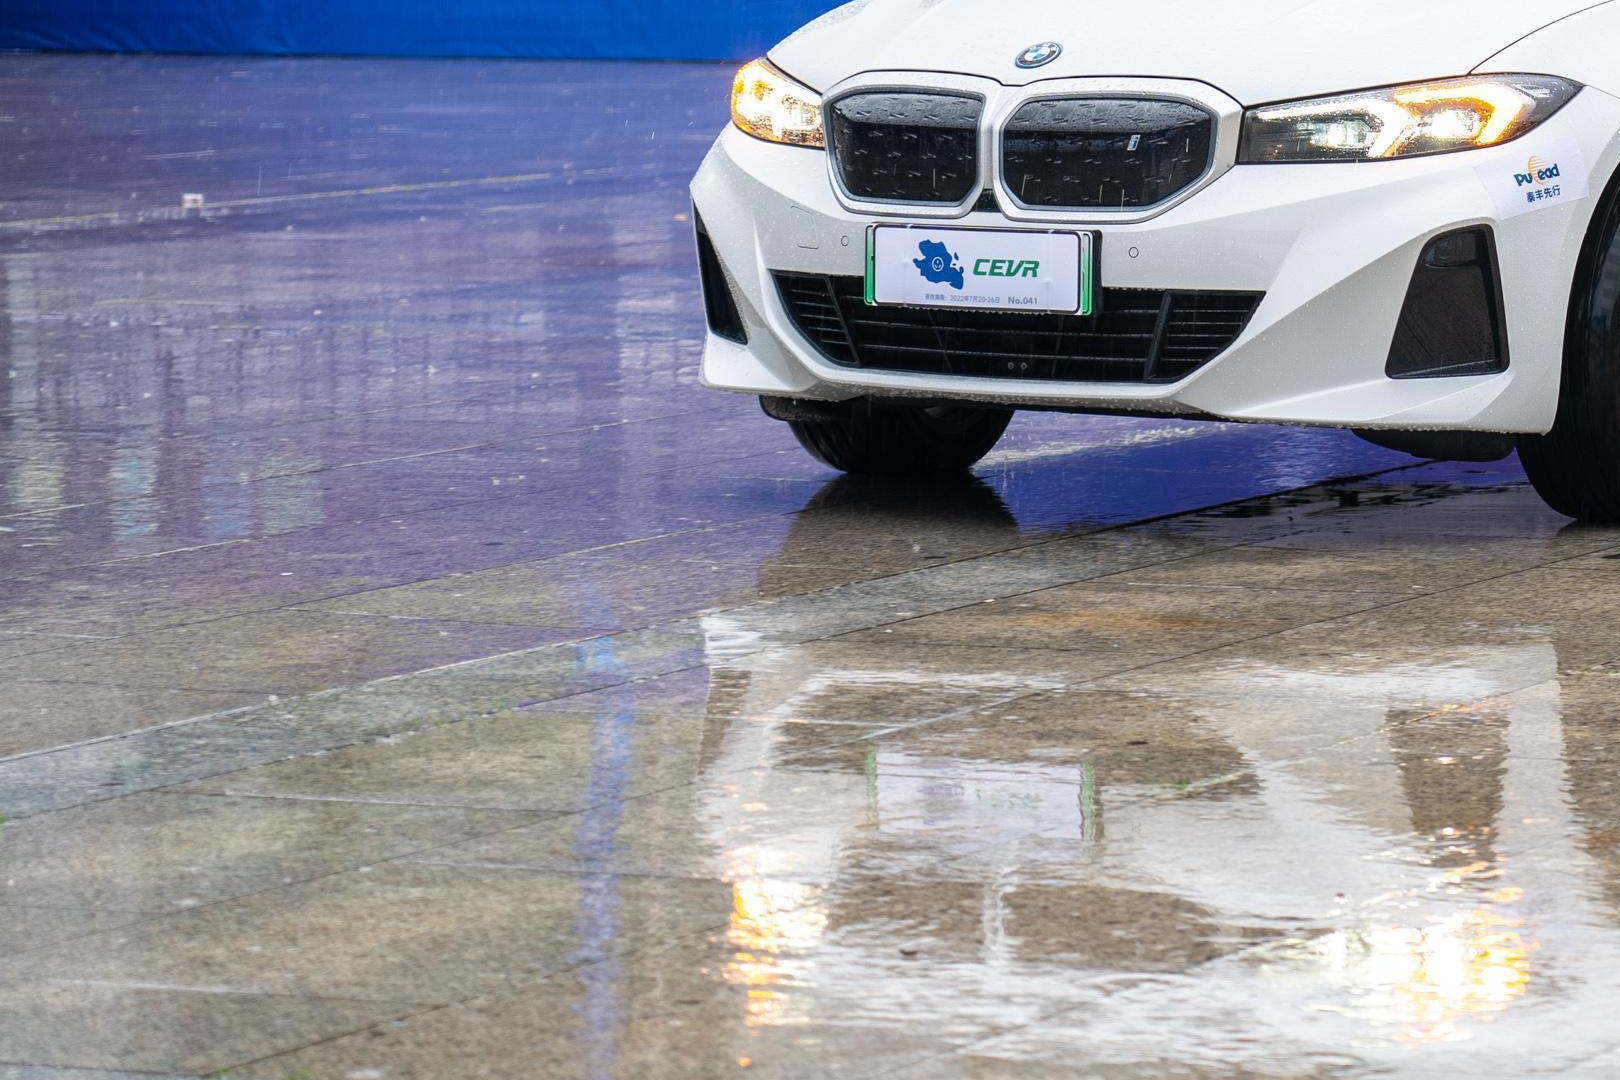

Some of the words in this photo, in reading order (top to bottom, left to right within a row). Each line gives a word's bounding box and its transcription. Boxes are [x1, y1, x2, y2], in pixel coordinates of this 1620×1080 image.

[1526, 184, 1561, 203] 泰丰先行
[972, 258, 1040, 278] CEVR
[1008, 296, 1038, 305] No.041
